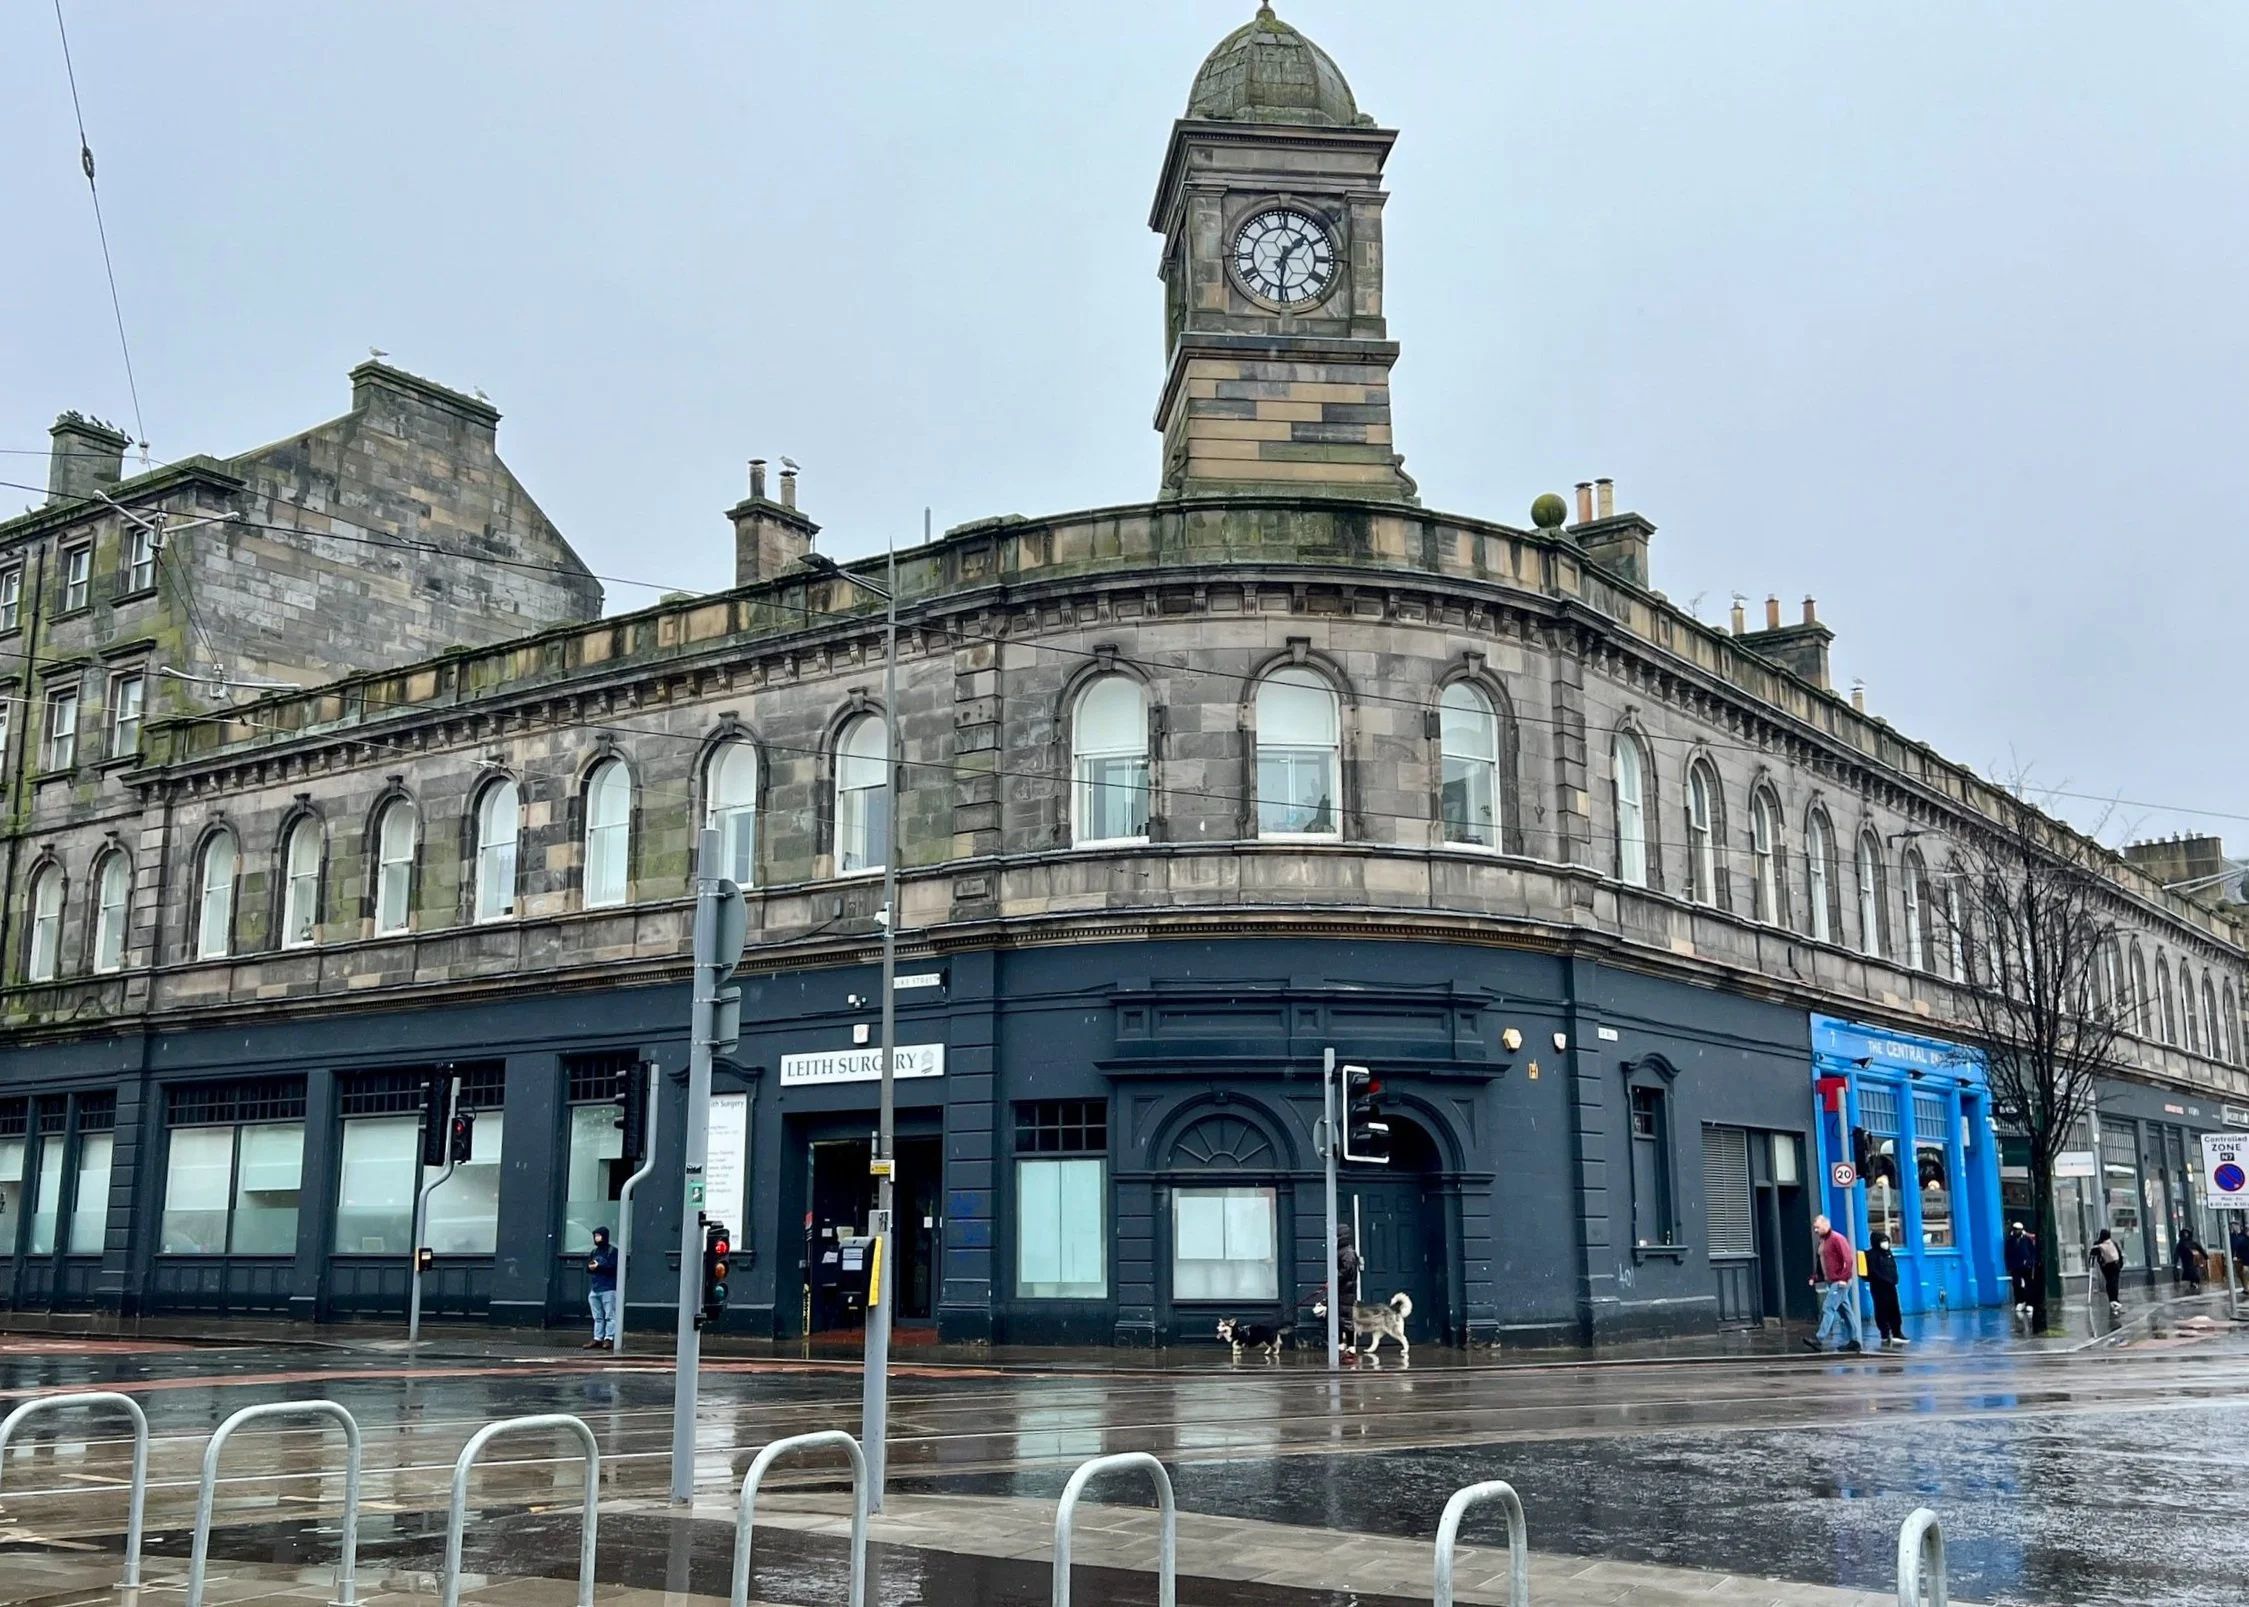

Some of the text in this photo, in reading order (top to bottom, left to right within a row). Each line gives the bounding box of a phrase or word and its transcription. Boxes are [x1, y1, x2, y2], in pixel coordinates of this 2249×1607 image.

[1868, 1040, 1883, 1054] THE
[1887, 1040, 1928, 1064] CENTRAL
[787, 1052, 917, 1077] LEITH SURGRY
[2204, 1135, 2248, 1143] Controlled
[2211, 1143, 2242, 1152] ZONE
[1837, 1170, 1851, 1179] 20
